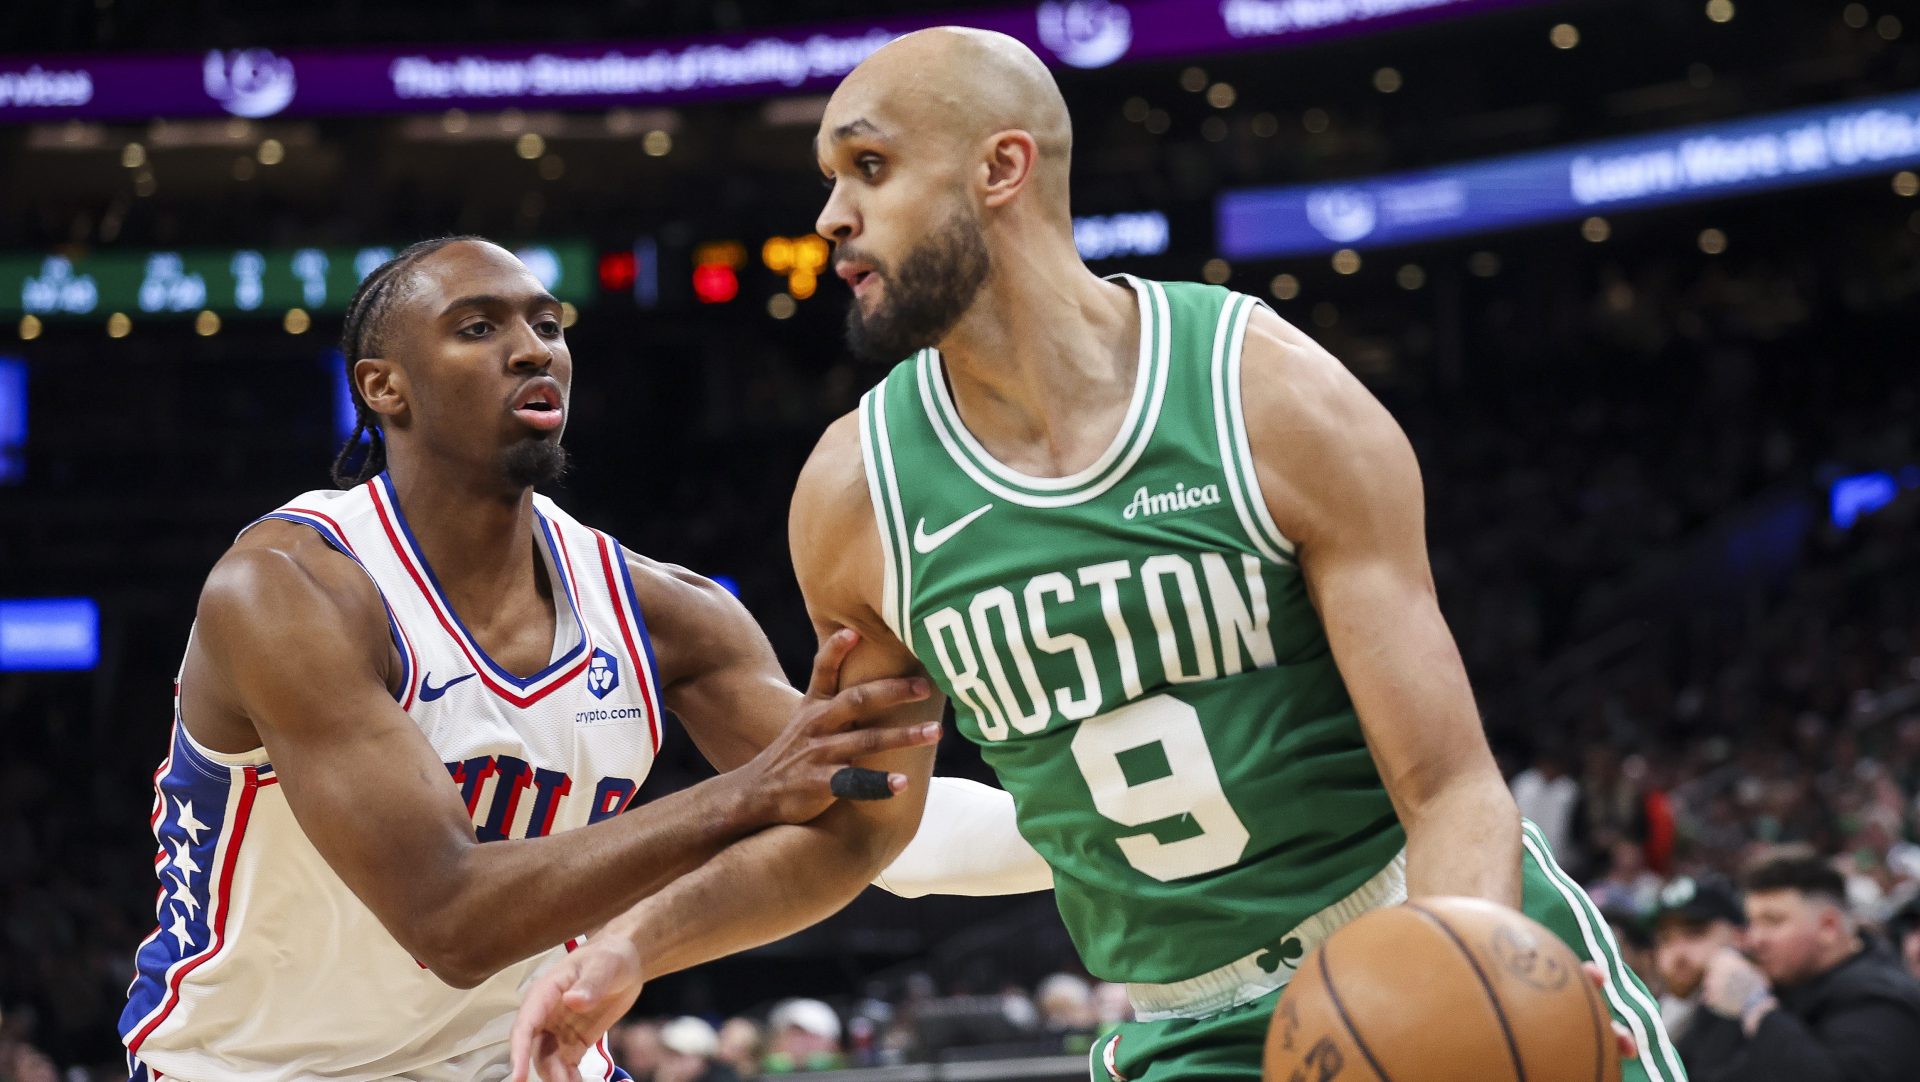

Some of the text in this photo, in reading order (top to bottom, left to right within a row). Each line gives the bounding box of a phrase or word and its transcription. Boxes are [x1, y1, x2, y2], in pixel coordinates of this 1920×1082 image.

[1123, 482, 1221, 520] Amica
[923, 553, 1277, 742] BOSTON
[575, 706, 642, 724] crypto.com
[1070, 693, 1251, 883] 9
